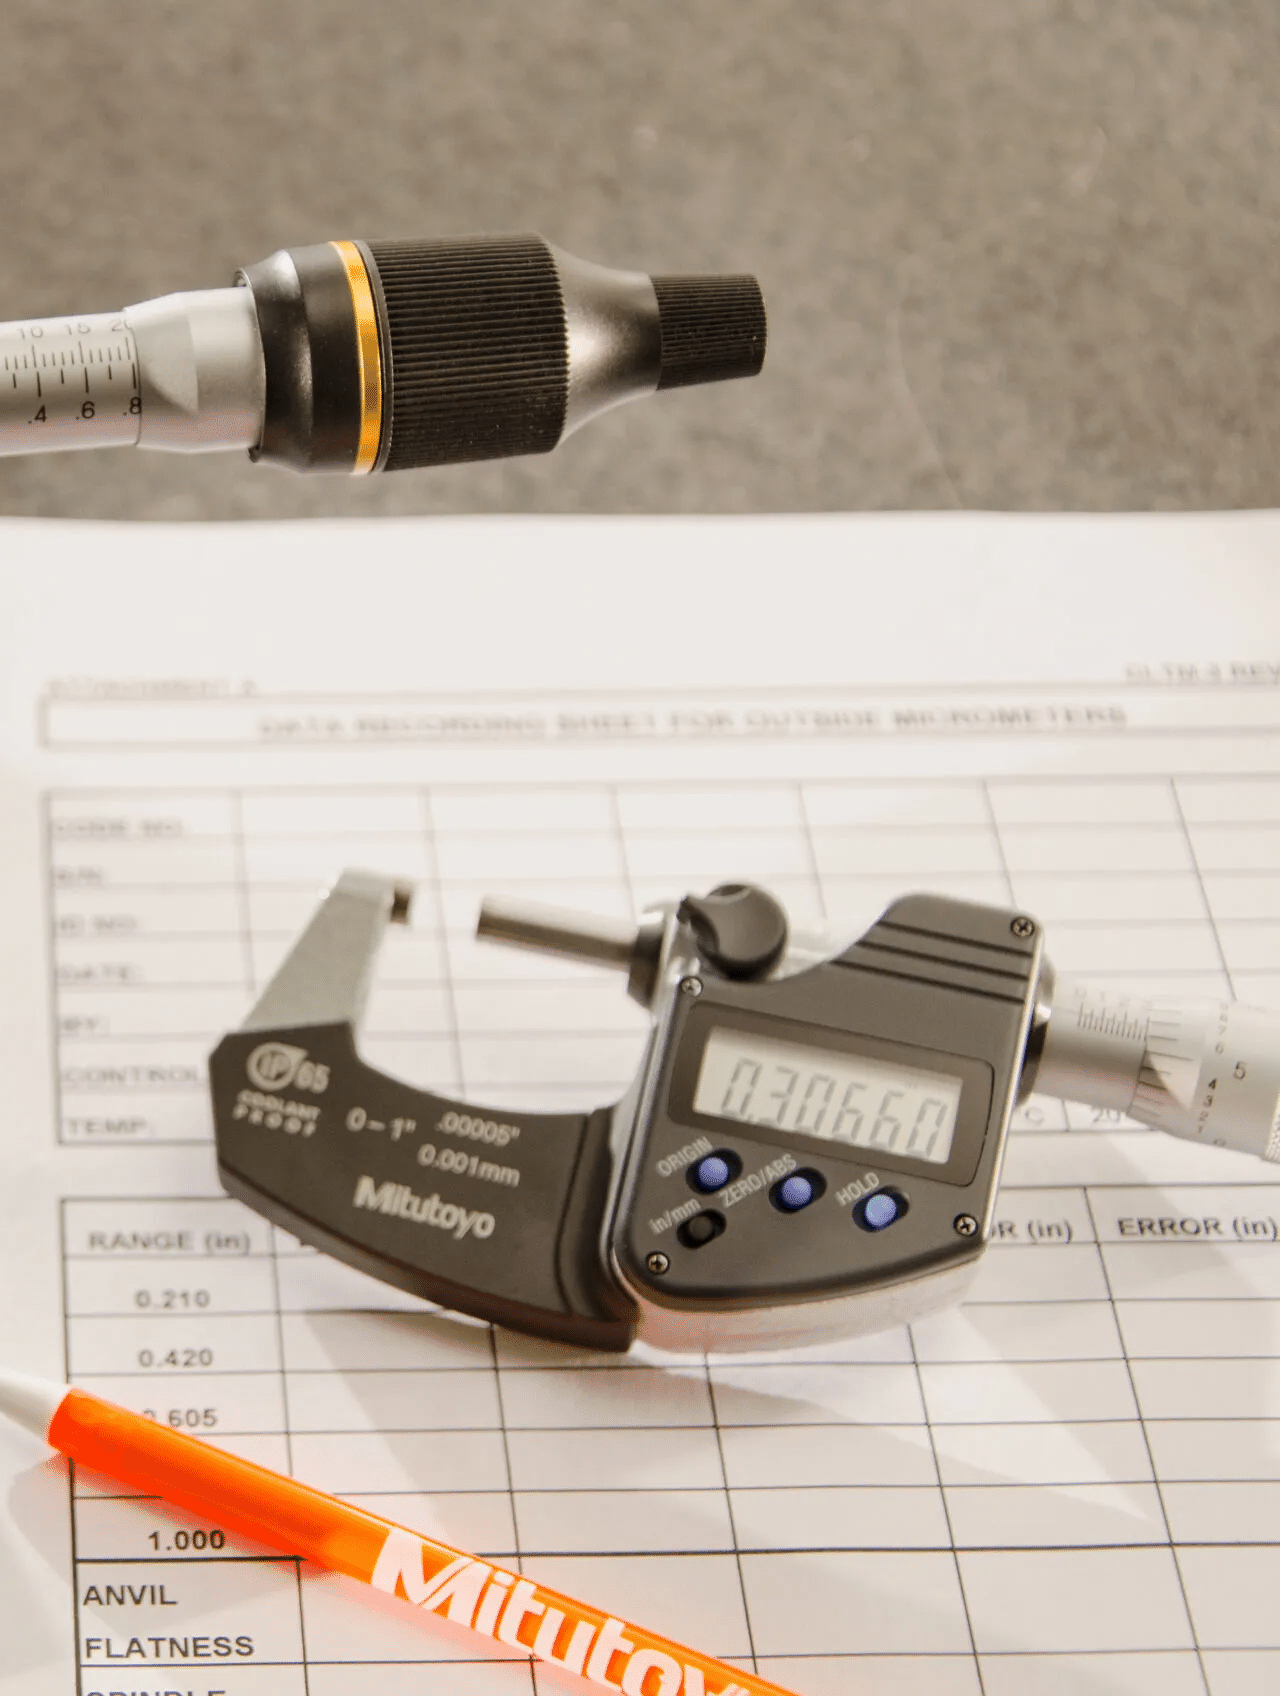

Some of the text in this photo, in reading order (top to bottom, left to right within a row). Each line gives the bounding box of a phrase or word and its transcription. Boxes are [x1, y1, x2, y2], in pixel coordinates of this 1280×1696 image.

[28, 405, 47, 424] .4
[76, 401, 95, 419] .6
[123, 397, 141, 416] .8
[1234, 1060, 1248, 1080] 5
[720, 1058, 948, 1158] 0.30660
[418, 1143, 520, 1188] 0.001mm
[656, 1136, 714, 1178] ORIGIN
[719, 1153, 798, 1208] ZERO/ABS
[835, 1171, 880, 1207] HOLD
[353, 1174, 495, 1240] Mitutoyo
[1027, 1219, 1074, 1245] (in)
[1118, 1216, 1278, 1244] ERROR (in)
[88, 1231, 251, 1257] RANGE (in)
[135, 1289, 211, 1309] 0.210
[138, 1349, 214, 1368] 0.420
[148, 1529, 226, 1551] 1.000
[83, 1584, 178, 1606] ANVIL
[85, 1636, 255, 1659] FLATNESS
